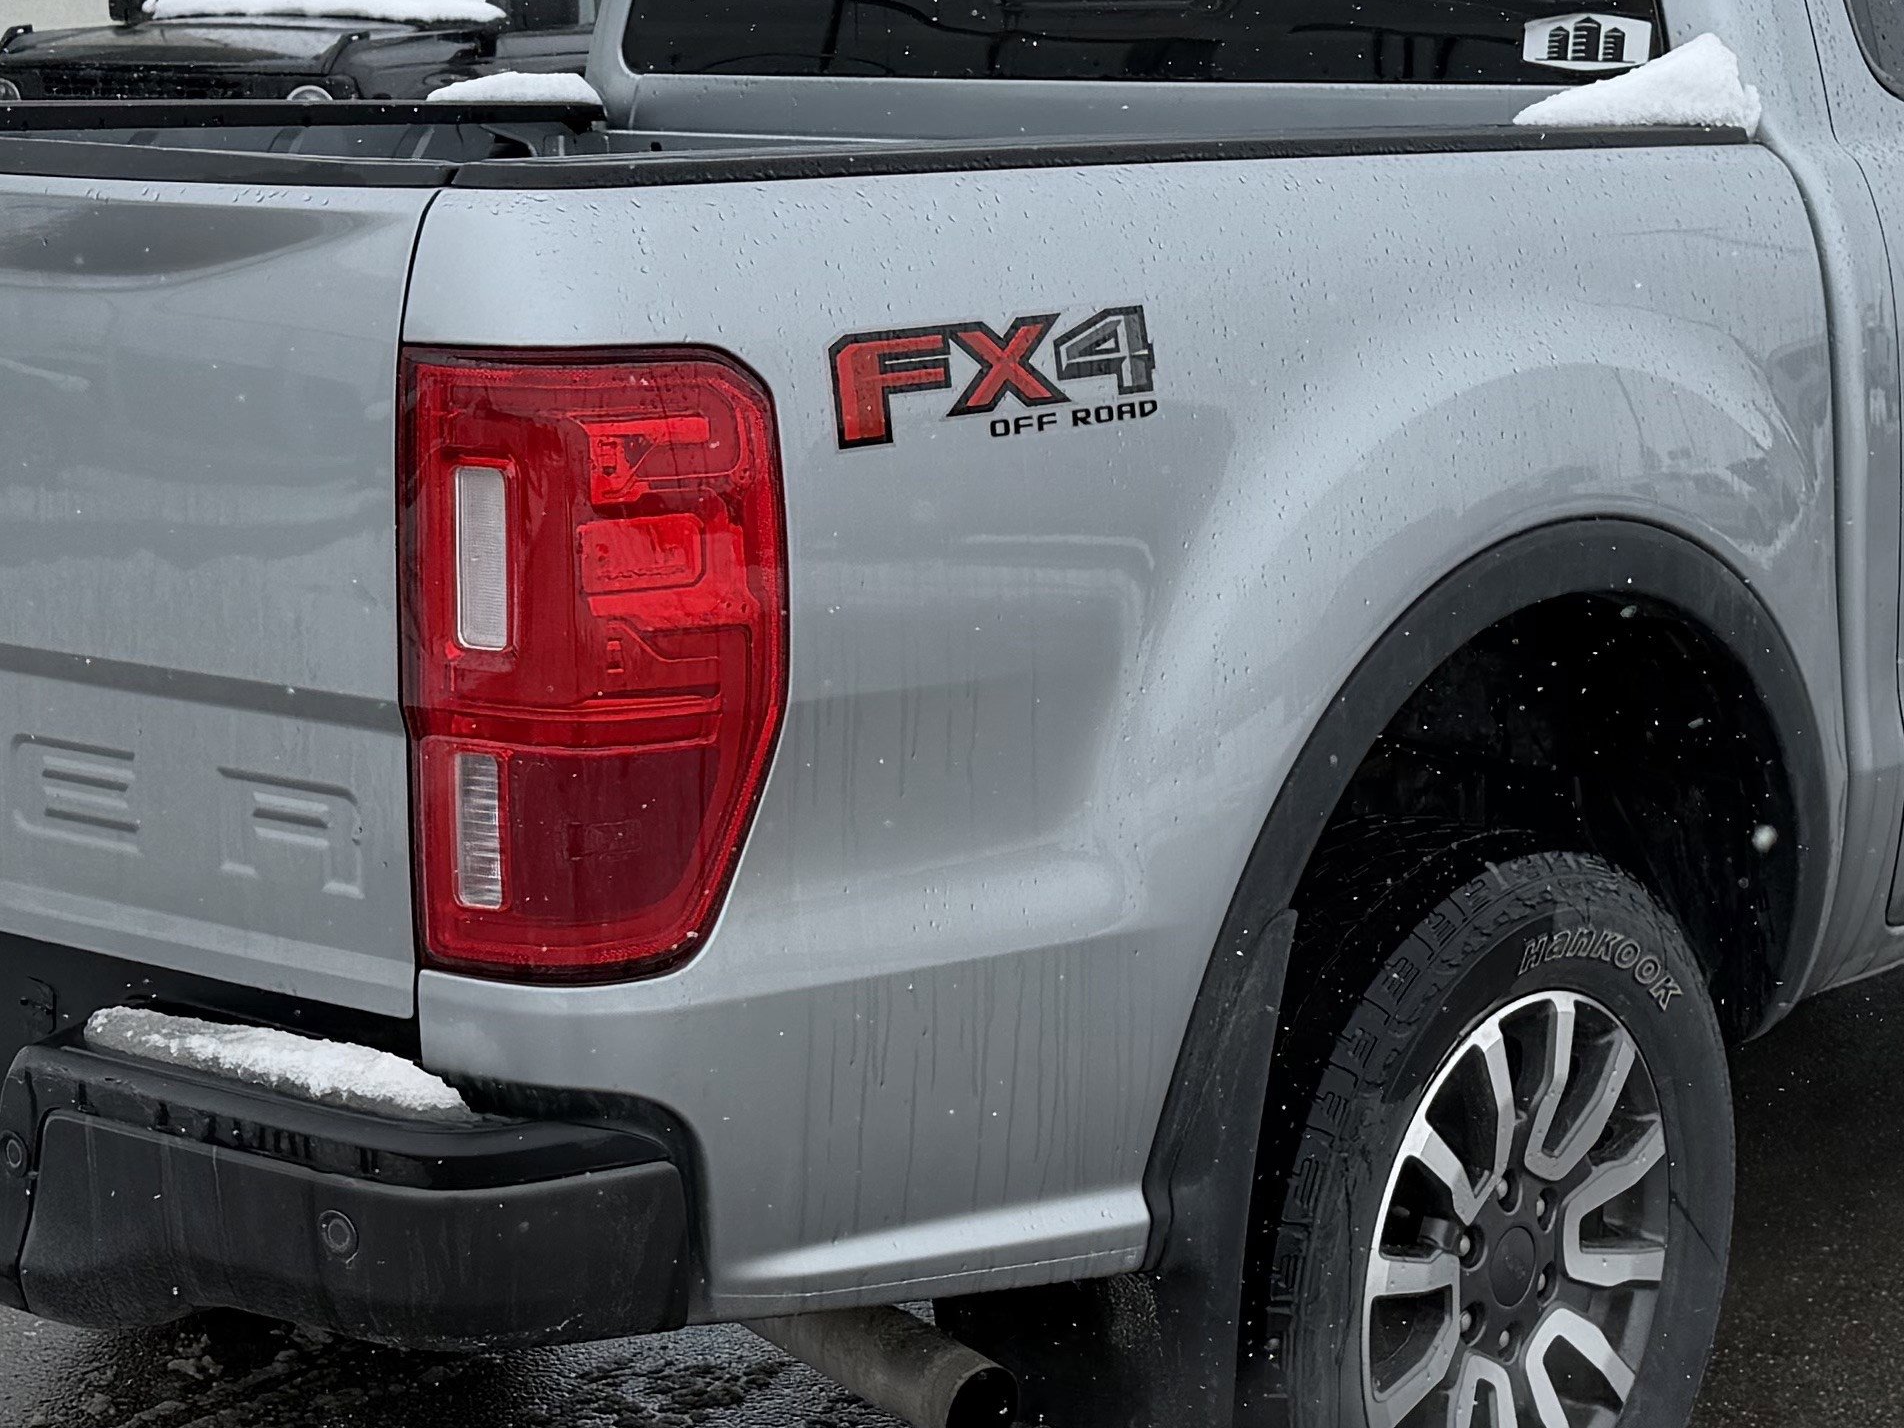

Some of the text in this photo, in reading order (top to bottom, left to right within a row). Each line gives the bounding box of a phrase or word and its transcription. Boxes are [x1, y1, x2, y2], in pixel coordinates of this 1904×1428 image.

[828, 305, 1156, 450] FX4
[989, 399, 1159, 439] OFF ROAD
